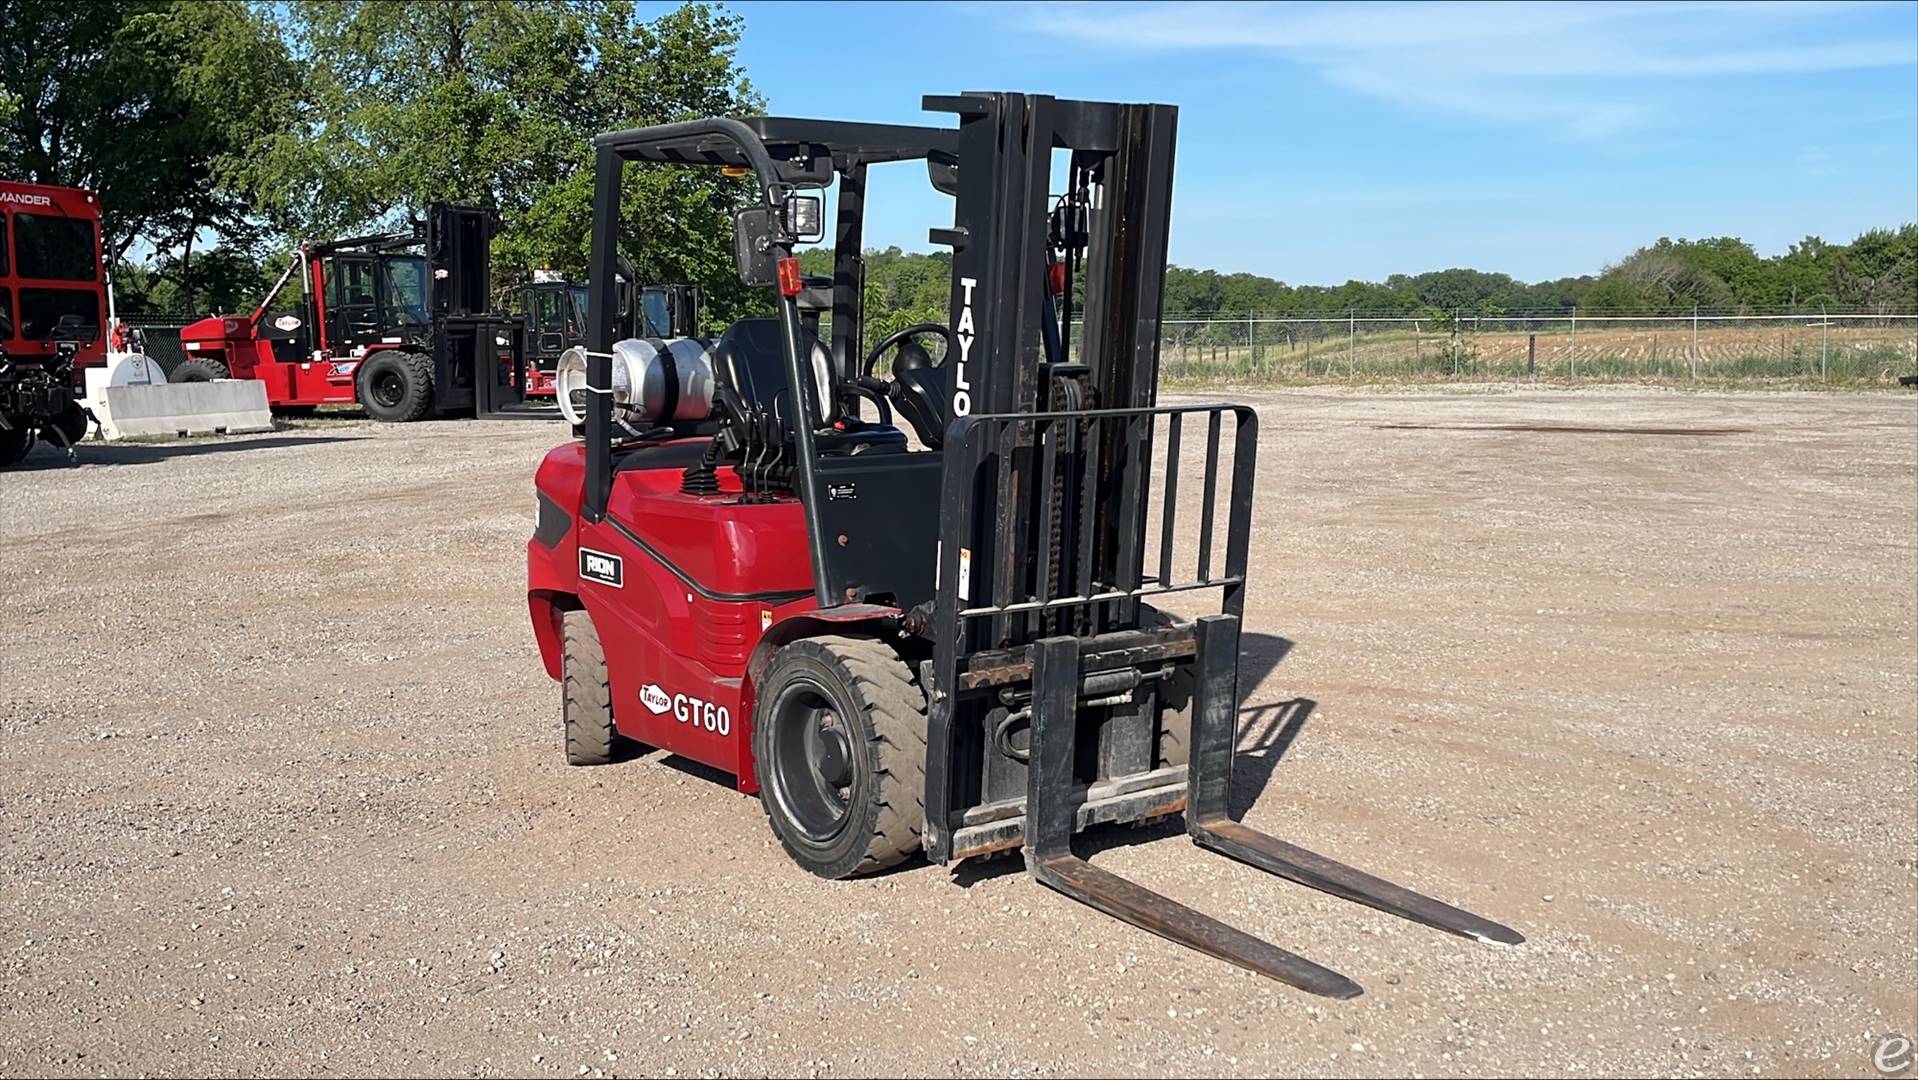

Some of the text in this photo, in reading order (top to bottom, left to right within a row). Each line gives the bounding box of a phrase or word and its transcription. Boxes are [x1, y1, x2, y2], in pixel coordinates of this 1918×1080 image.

[953, 277, 977, 417] TAYLO
[586, 554, 615, 577] RION
[643, 686, 730, 736] TAYLOR GT60
